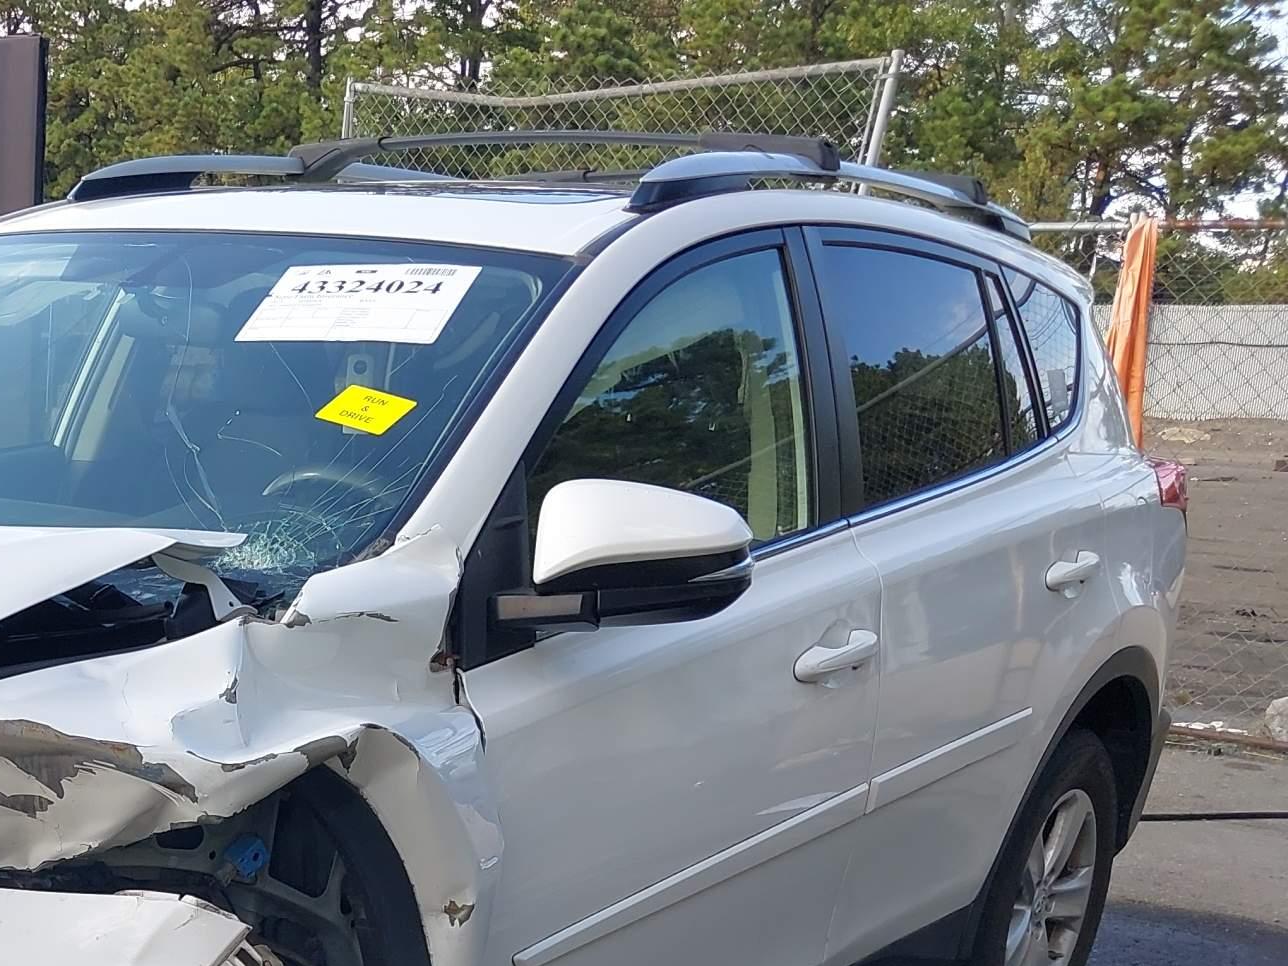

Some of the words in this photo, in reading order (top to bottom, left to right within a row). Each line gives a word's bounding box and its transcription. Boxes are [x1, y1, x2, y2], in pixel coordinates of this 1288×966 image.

[291, 279, 444, 294] 43324024
[363, 395, 389, 406] RUN
[360, 405, 370, 413] &
[338, 409, 375, 424] DRIVE
